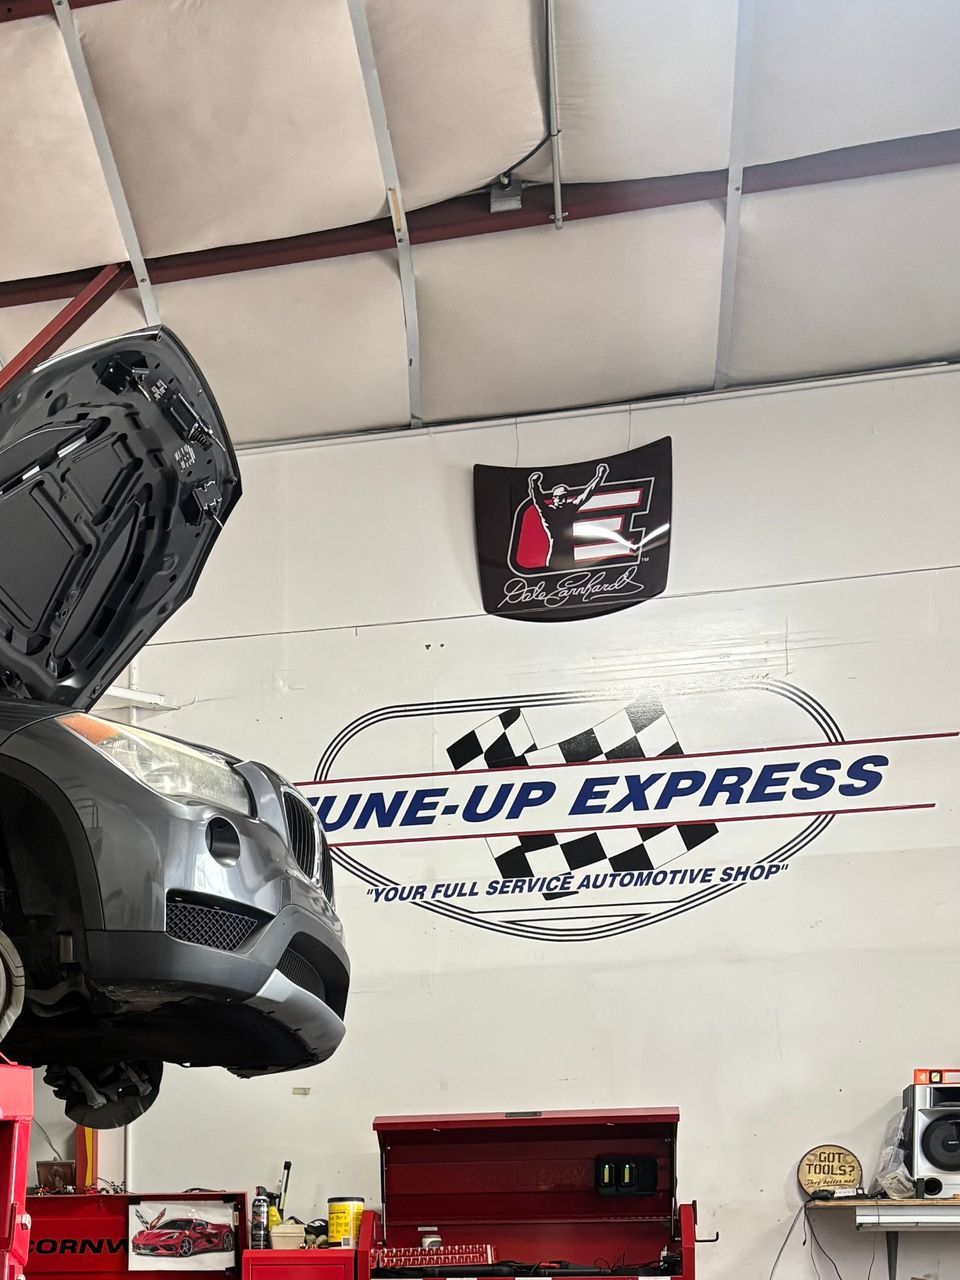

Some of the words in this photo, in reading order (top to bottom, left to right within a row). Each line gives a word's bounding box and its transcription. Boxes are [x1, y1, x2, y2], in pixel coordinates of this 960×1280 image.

[498, 577, 550, 608] Dale
[570, 754, 889, 816] EXPRESS
[367, 885, 427, 903] "YOUR
[431, 881, 479, 899] FULL
[486, 875, 574, 896] SERVICE
[577, 867, 716, 890] AUTOMOTIVE
[719, 863, 789, 882] SHOP"
[806, 1163, 855, 1177] TOOLS?
[818, 1151, 844, 1163] GOT
